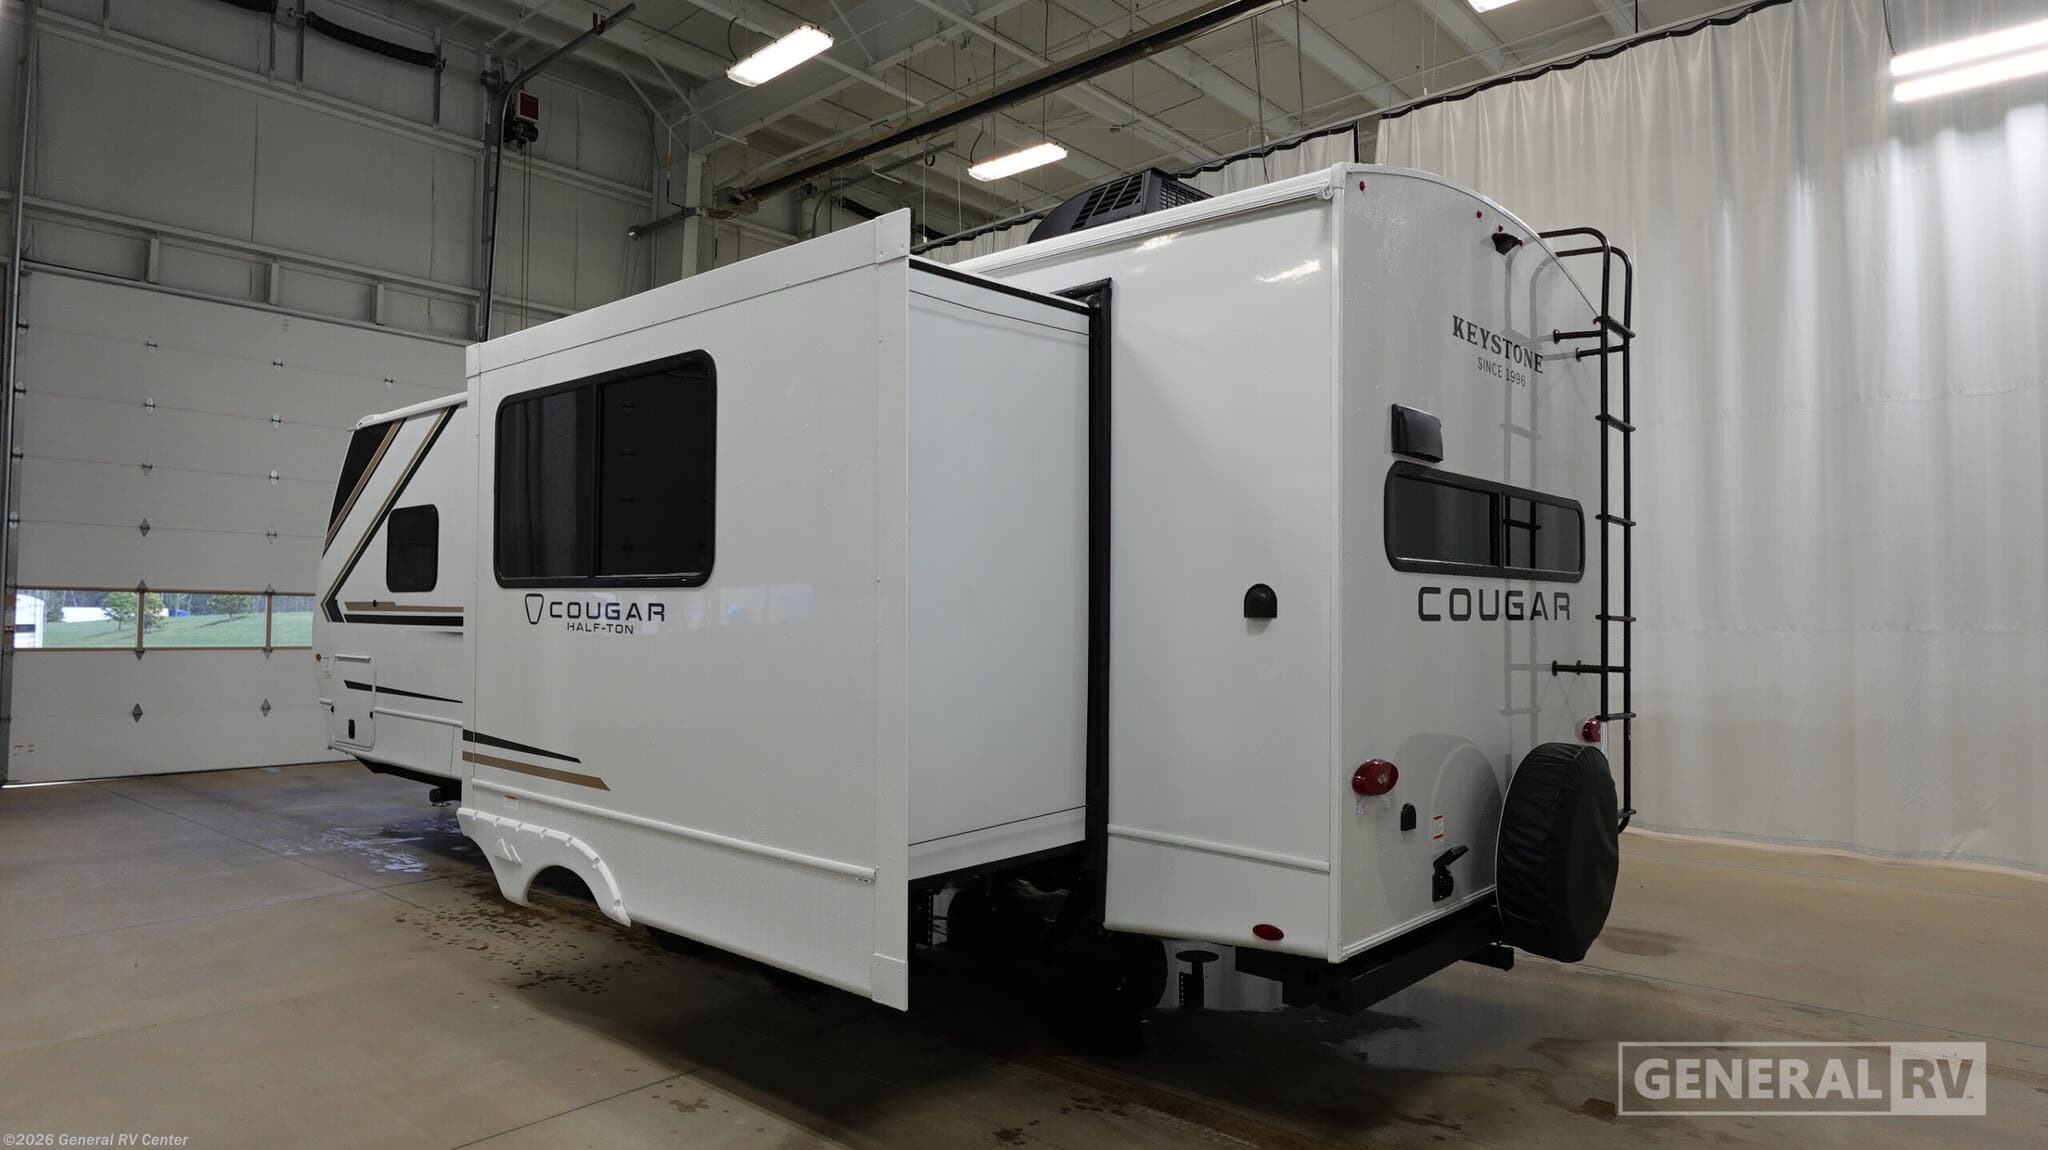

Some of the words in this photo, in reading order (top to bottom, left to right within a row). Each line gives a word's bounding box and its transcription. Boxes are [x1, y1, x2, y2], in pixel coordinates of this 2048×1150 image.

[1453, 314, 1543, 374] KEYSTONE
[1477, 356, 1503, 378] SINCE
[1506, 368, 1527, 388] 1996
[550, 602, 665, 622] COUGAR
[1418, 586, 1570, 622] COUGAR
[567, 622, 634, 634] HALF-TON
